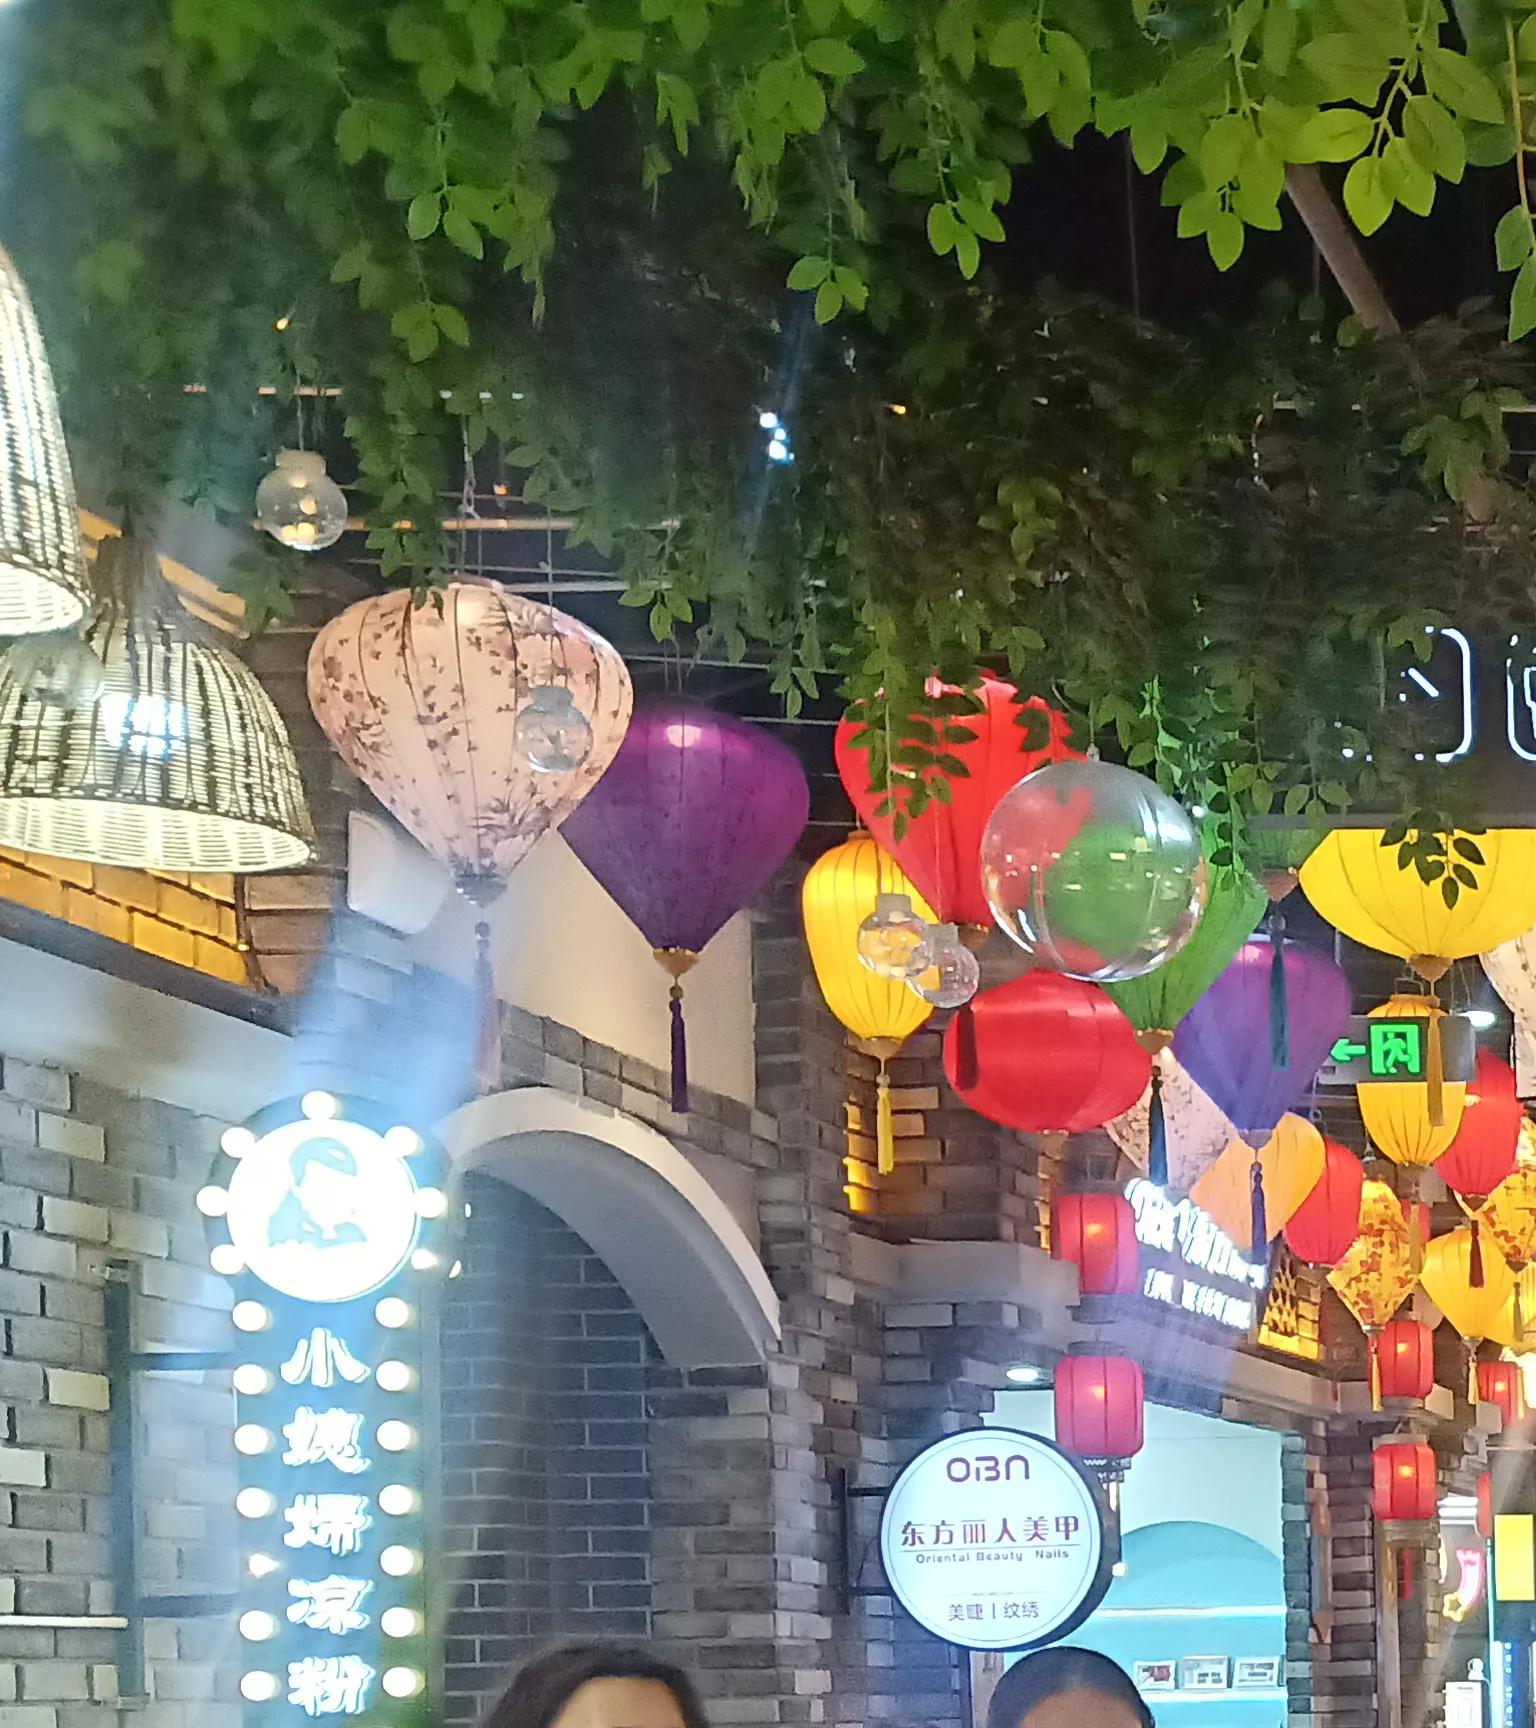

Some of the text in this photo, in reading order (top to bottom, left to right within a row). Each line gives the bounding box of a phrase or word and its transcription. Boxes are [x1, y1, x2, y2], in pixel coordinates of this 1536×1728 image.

[901, 1515, 1079, 1547] 东方丽人美甲
[916, 1549, 1070, 1564] Oriental Beauty Nails
